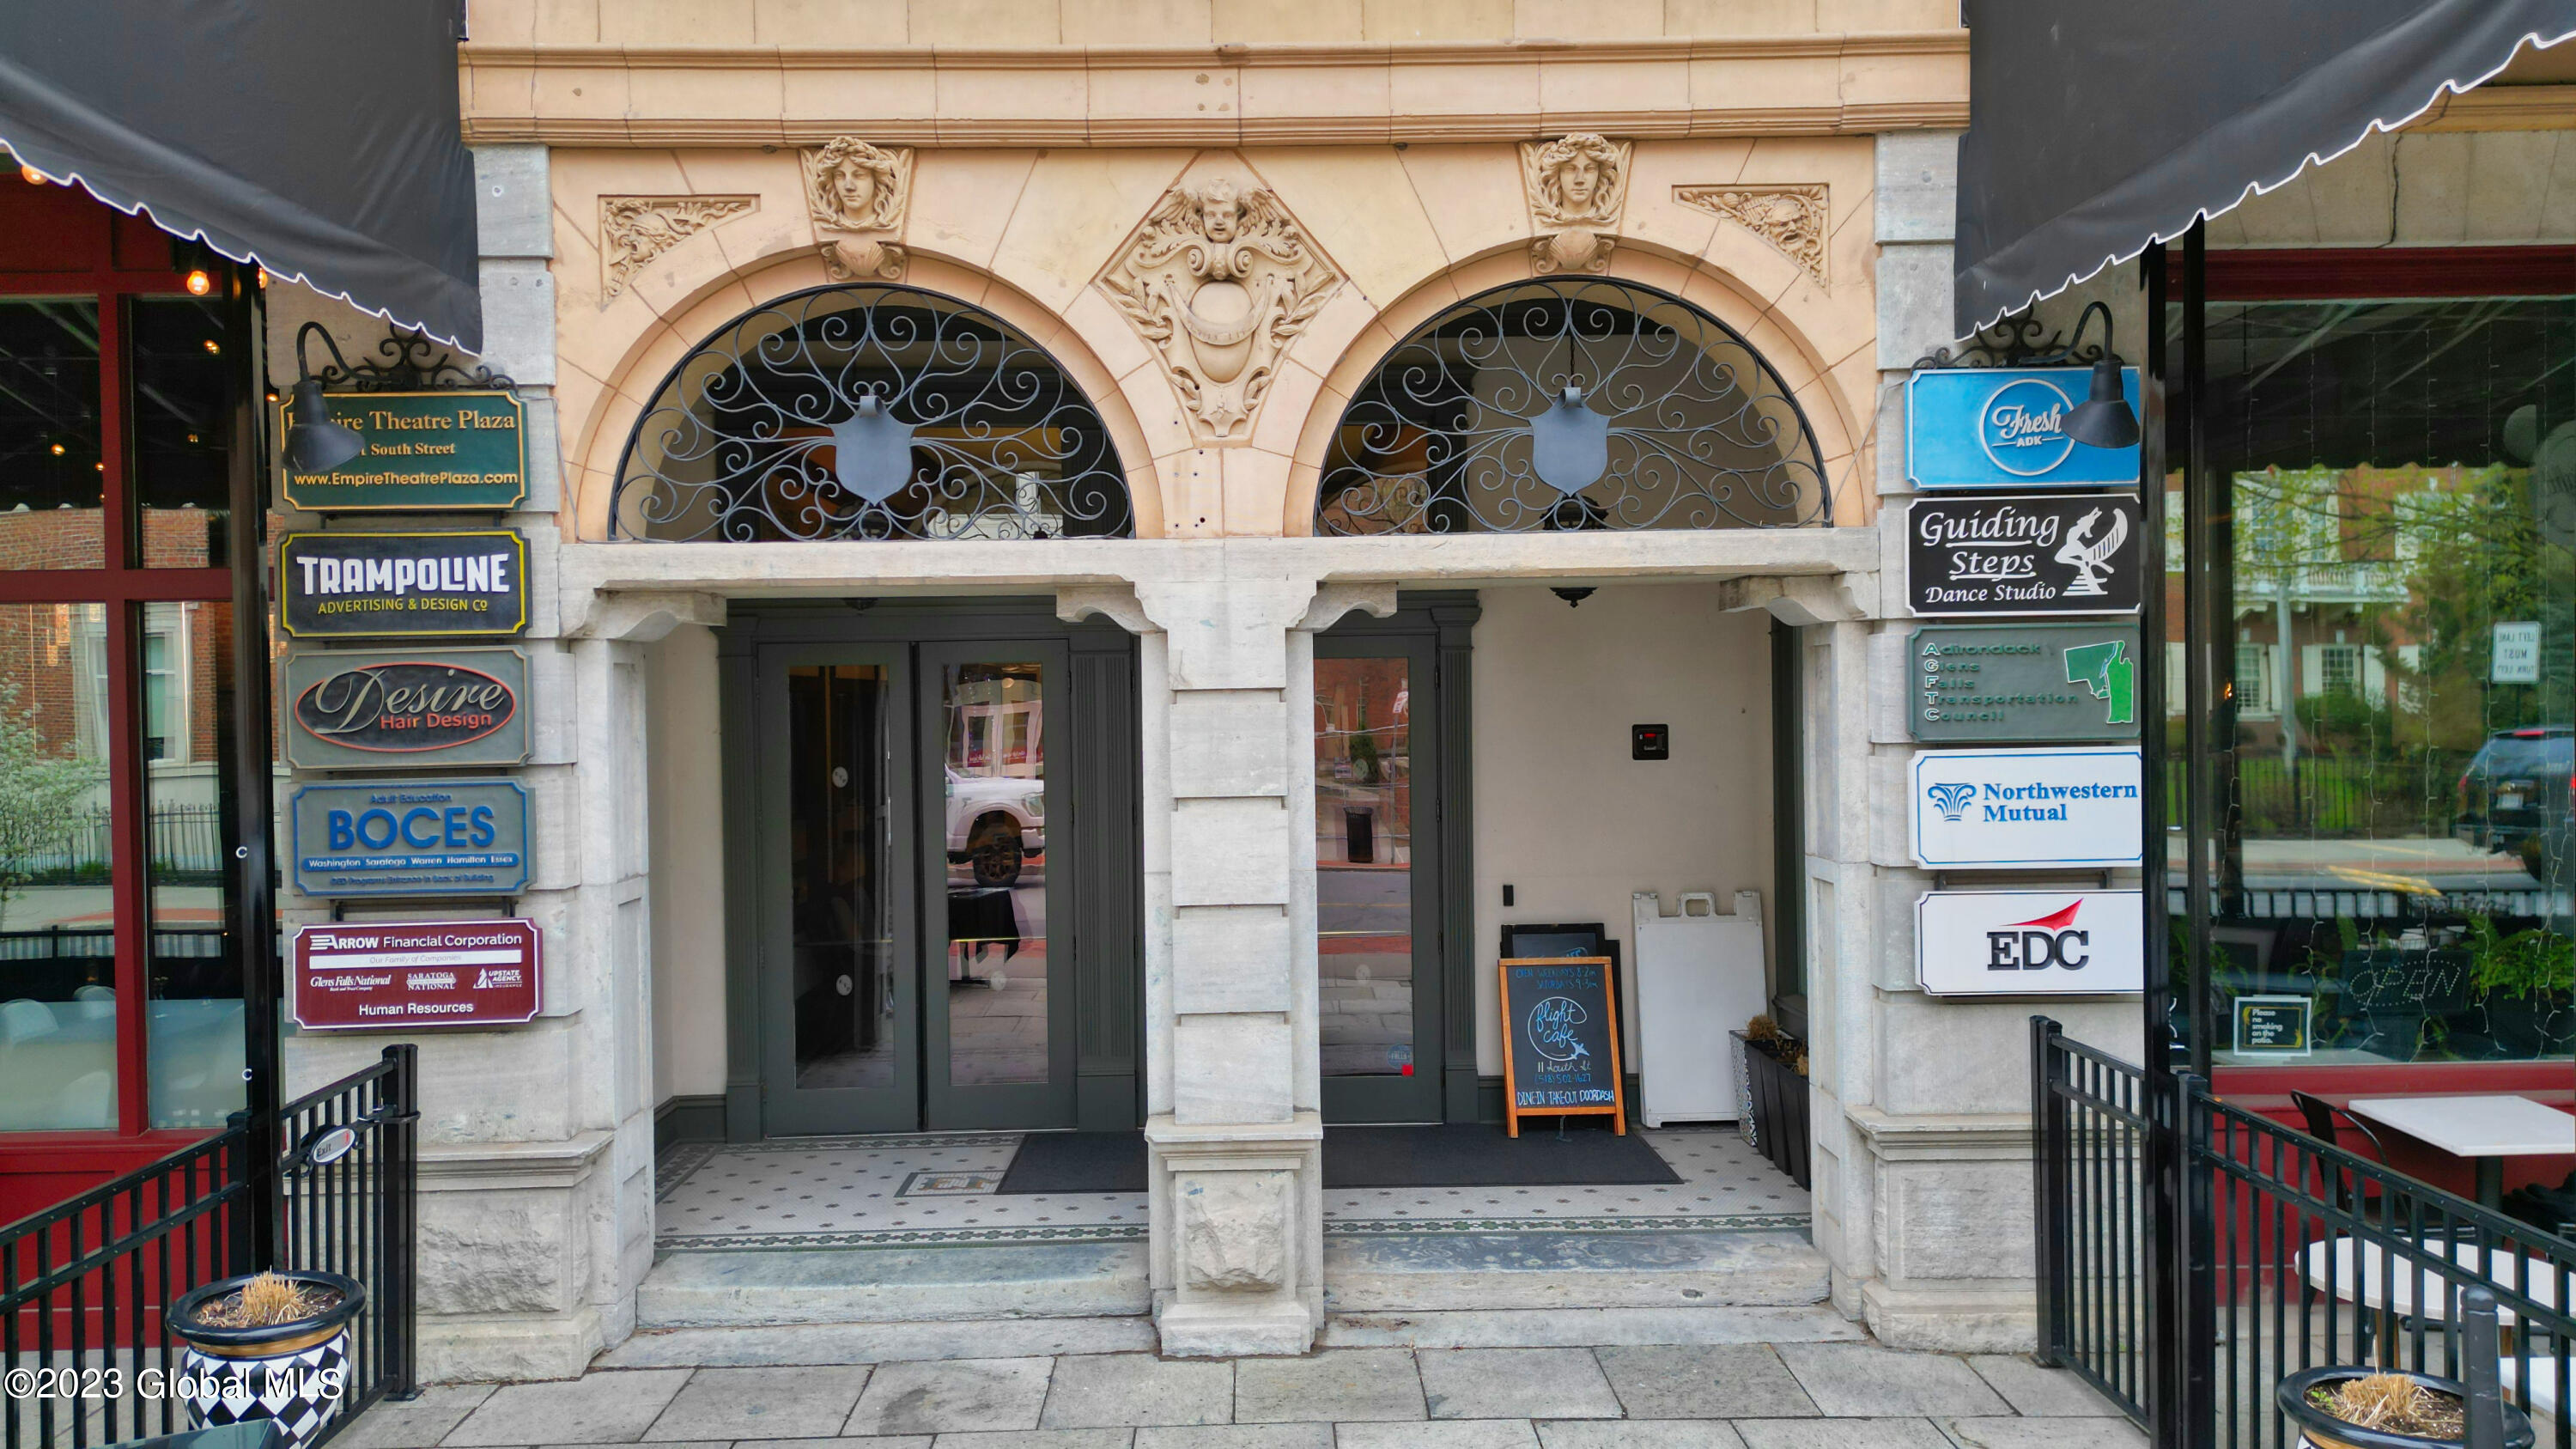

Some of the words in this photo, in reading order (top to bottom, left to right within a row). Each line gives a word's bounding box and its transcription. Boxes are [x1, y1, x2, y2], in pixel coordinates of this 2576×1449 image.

[369, 411, 453, 430] Theatre
[458, 410, 516, 429] Plaza
[1991, 402, 2063, 439] Fresh
[371, 443, 411, 456] South
[415, 442, 456, 455] Street
[2016, 435, 2043, 447] ADK
[294, 472, 518, 488] www.EmpireTheatrePlaza.com
[1920, 506, 2060, 547] Guiding
[296, 553, 510, 596] TRAMPOLINE
[1948, 551, 2036, 582] Steps
[1925, 586, 1988, 603] Dance
[1994, 581, 2057, 600] Studio
[317, 598, 404, 614] ADVERTISING
[407, 598, 417, 611] &
[421, 598, 468, 612] DESIGN
[1922, 642, 2041, 656] Adirondack
[1923, 659, 1980, 673] Glens
[1924, 675, 1975, 689] Falls
[314, 668, 507, 734] Desire
[1924, 691, 2079, 707] Transportation
[380, 714, 421, 729] Hair
[427, 712, 492, 728] Design
[1924, 708, 2005, 721] Council
[369, 794, 397, 804] Adult
[399, 793, 453, 803] Education
[1983, 782, 2138, 801] Northwestern
[1983, 804, 2069, 823] Mutual
[328, 805, 495, 850] BOCES
[309, 859, 361, 869] Washington
[365, 857, 407, 868] Saratoga
[447, 855, 487, 864] Hamilton
[309, 935, 379, 951] ARROW
[384, 935, 442, 949] Financial
[445, 933, 522, 948] Corporation
[1986, 929, 2089, 971] EDC
[369, 956, 383, 965] Our
[385, 955, 409, 965] Family
[420, 954, 462, 965] Companies
[310, 976, 335, 988] Glens
[335, 975, 355, 987] Falls
[354, 974, 392, 987] National
[2349, 965, 2461, 997] OPEN
[359, 1003, 404, 1016] Human
[407, 1002, 474, 1015] Resources
[1535, 1000, 1577, 1032] flight
[2251, 1008, 2276, 1017] Please
[2251, 1022, 2283, 1032] smoking
[316, 1143, 331, 1158] Exit
